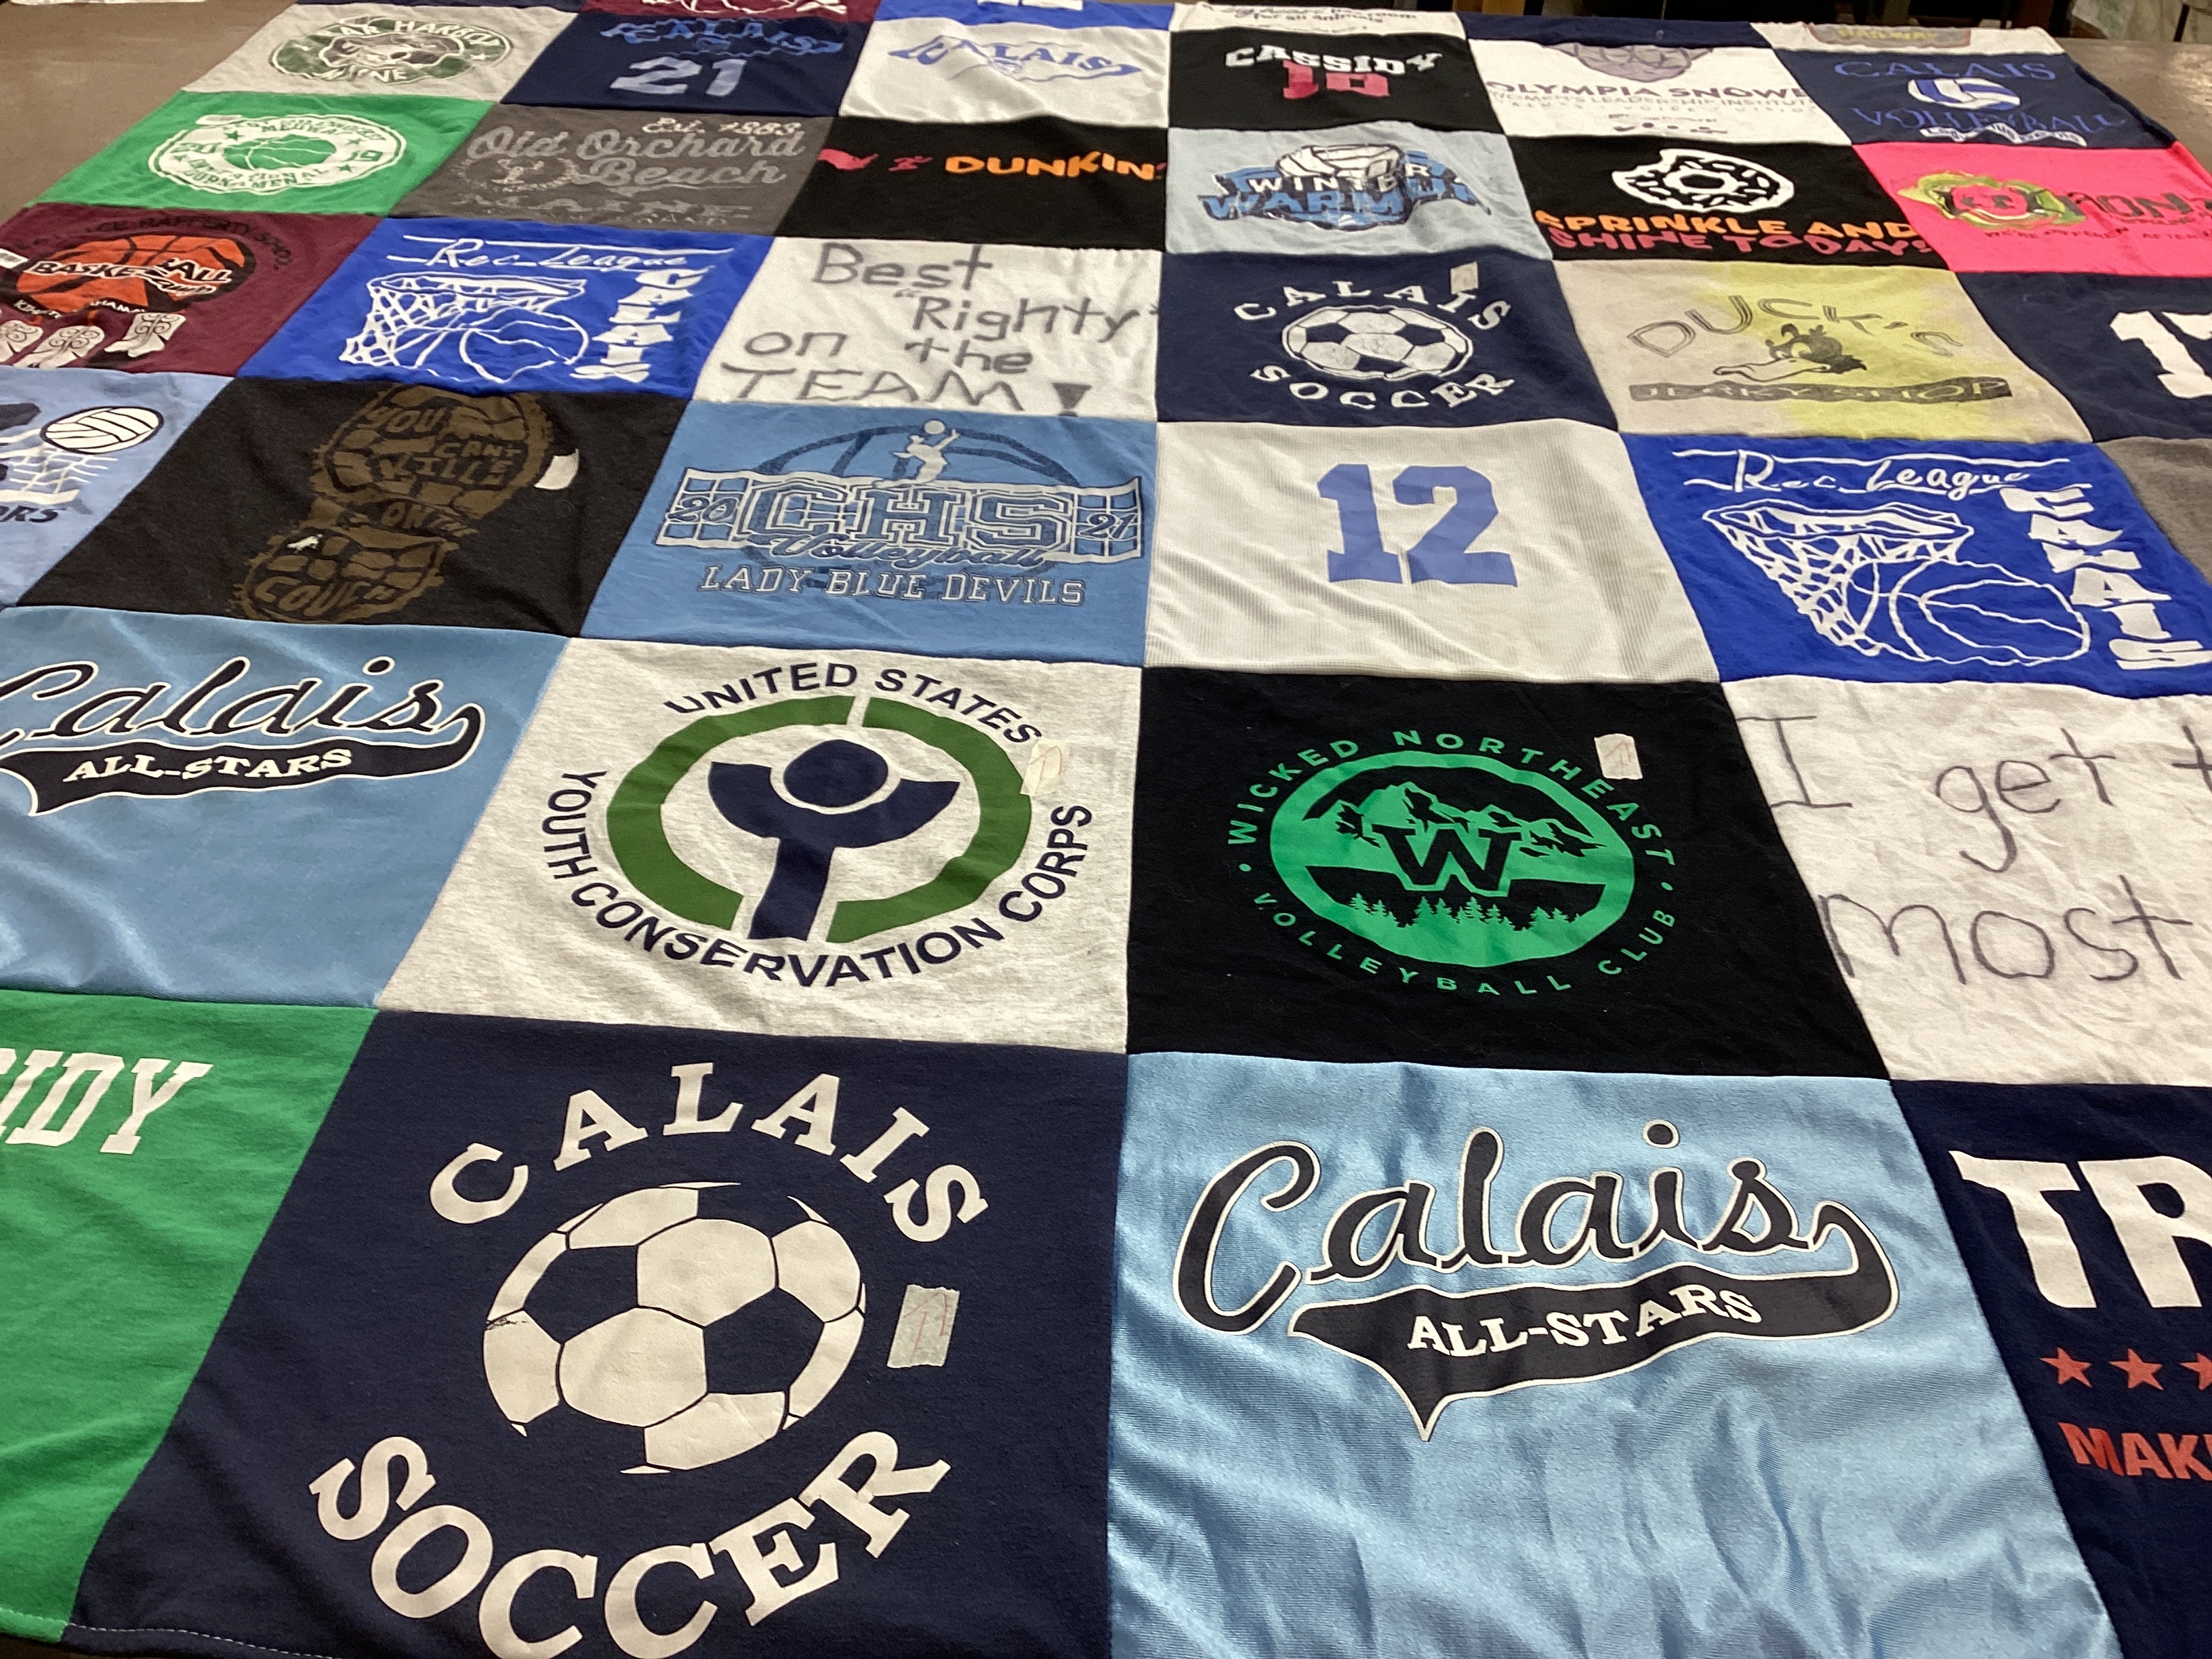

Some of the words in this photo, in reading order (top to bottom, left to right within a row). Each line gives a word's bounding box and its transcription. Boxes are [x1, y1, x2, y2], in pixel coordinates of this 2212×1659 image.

[609, 56, 747, 97] 21
[912, 39, 1115, 71] CALAIS
[1225, 45, 1443, 76] CASSIDY
[1834, 61, 2056, 81] CALAIS
[1486, 81, 1662, 97] OLYMPIA
[466, 125, 569, 159] Old
[576, 129, 808, 161] Orchard
[571, 157, 787, 186] Beach
[1535, 209, 1793, 235] SPRINKLE
[1807, 221, 1918, 240] AND
[1548, 227, 1713, 251] SHINE
[426, 239, 520, 267] Rec
[541, 246, 690, 272] League
[812, 242, 993, 291] Best
[1233, 279, 1511, 330] CALAIS
[744, 331, 848, 357] on
[903, 336, 1035, 374] the
[1250, 363, 1515, 409] SOCCER
[1734, 449, 1838, 493] Rec
[1865, 459, 2031, 500] League
[667, 497, 740, 523] 20
[735, 478, 1073, 550] CHS
[1317, 463, 1518, 588] 12
[769, 535, 1049, 569] Volleyball
[699, 564, 812, 595] LADY
[824, 567, 927, 602] BLUE
[941, 572, 1087, 606] DEVILS
[663, 661, 859, 716] UNITED
[875, 668, 1044, 744] STATES
[62, 747, 353, 783] ALL-STARS
[1227, 739, 1359, 846] WICKED
[1392, 729, 1676, 867] NORTHEAST
[1736, 714, 1853, 809] I
[1933, 726, 2117, 874] get
[541, 770, 608, 880] YOUTH
[998, 804, 1093, 923] CORPS
[1372, 823, 1522, 897] W
[571, 881, 1003, 988] CONSERVATION
[1253, 892, 1572, 996] VOLLEYBALL
[1597, 908, 1677, 976] CLUB
[1817, 874, 2194, 985] most
[0, 1047, 214, 1155] IDY
[429, 1061, 990, 1244] CALAIS
[1172, 1119, 1818, 1336] Calais
[1407, 1283, 1763, 1357] ALL-STARS
[307, 1429, 953, 1659] SOCCER
